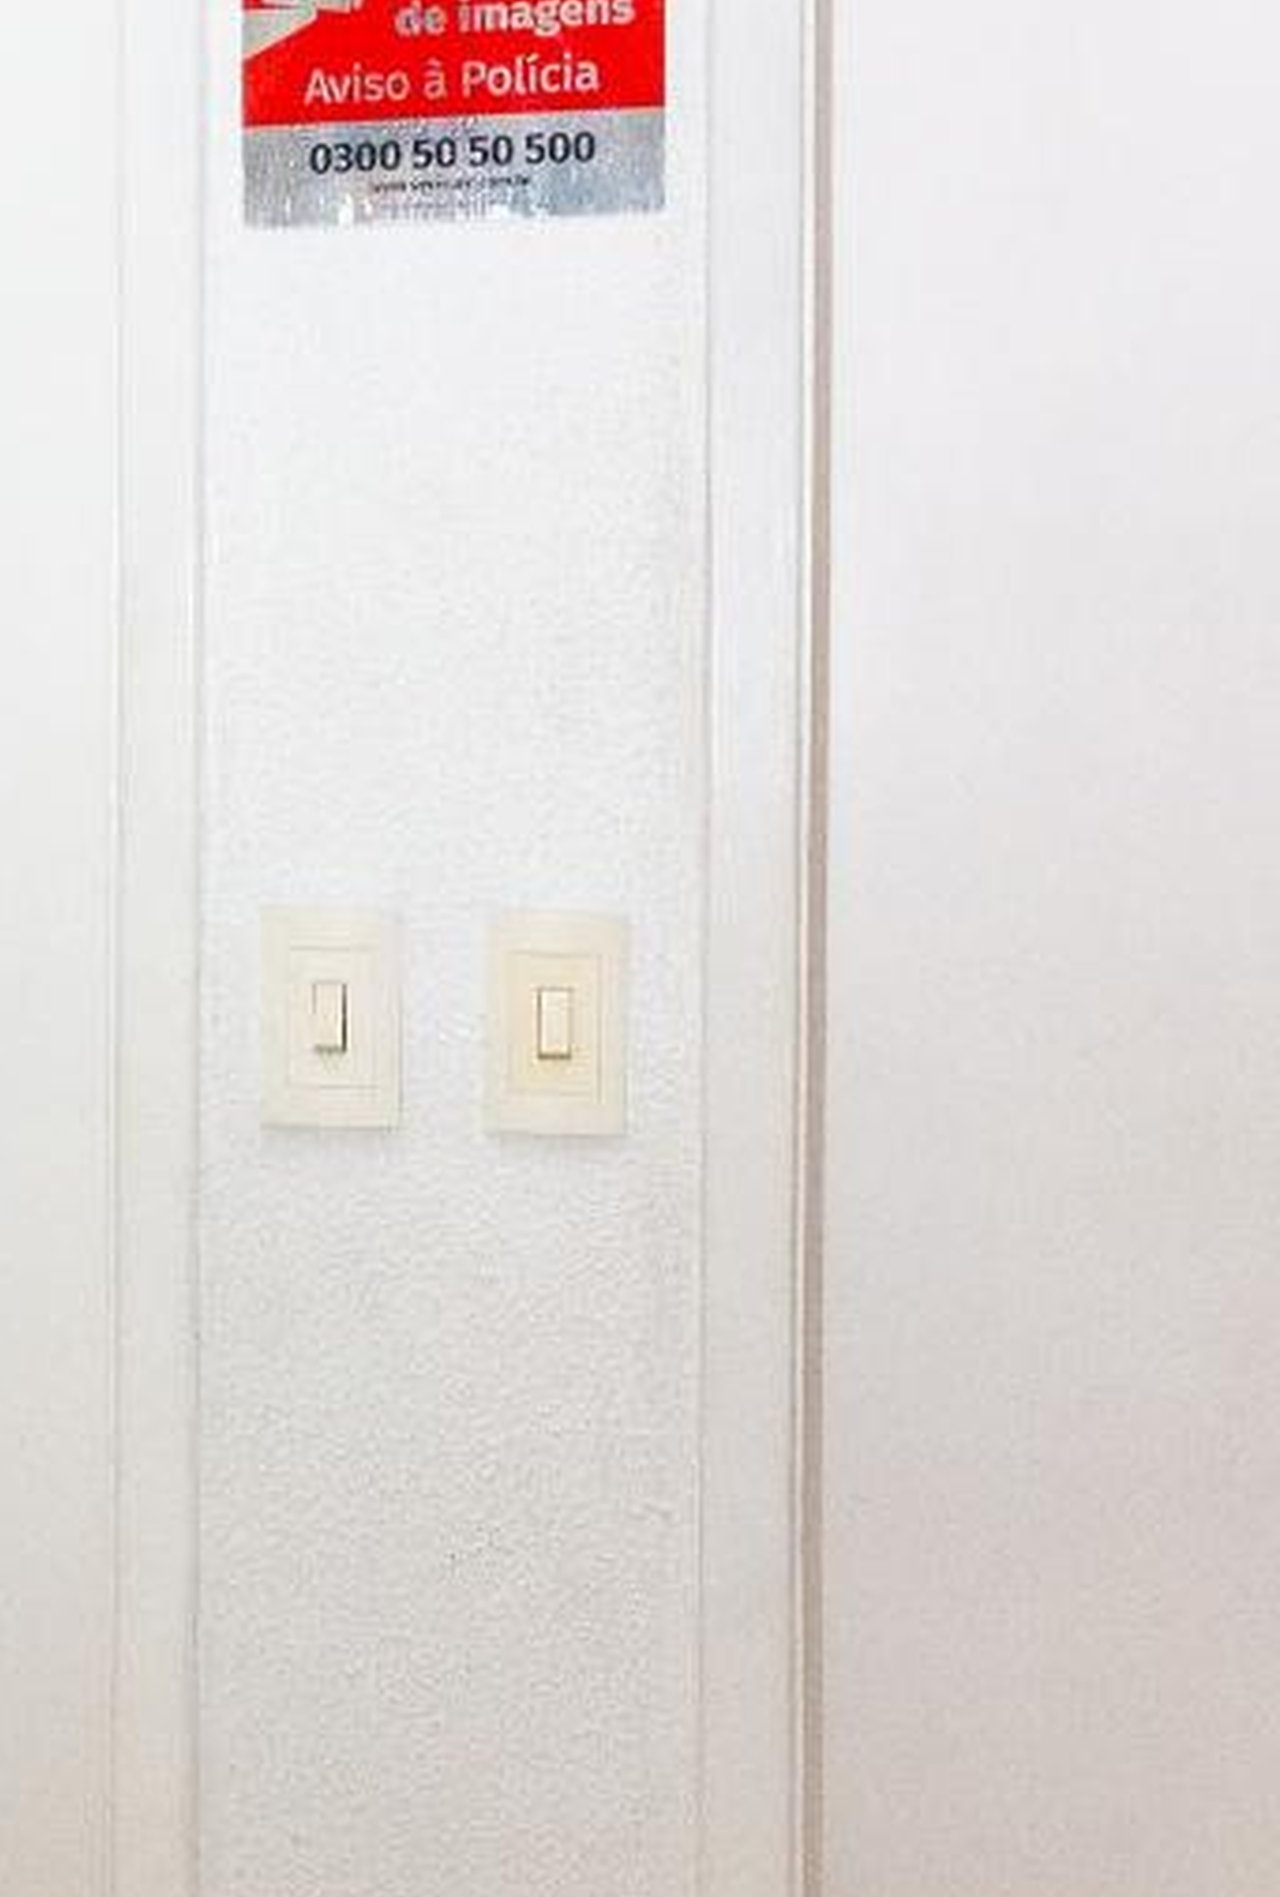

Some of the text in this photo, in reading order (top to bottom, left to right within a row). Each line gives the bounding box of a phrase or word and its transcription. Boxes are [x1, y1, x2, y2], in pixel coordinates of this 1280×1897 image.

[304, 62, 411, 105] Aviso
[462, 50, 600, 97] Polícia
[309, 131, 597, 175] 0300 50 50 500
